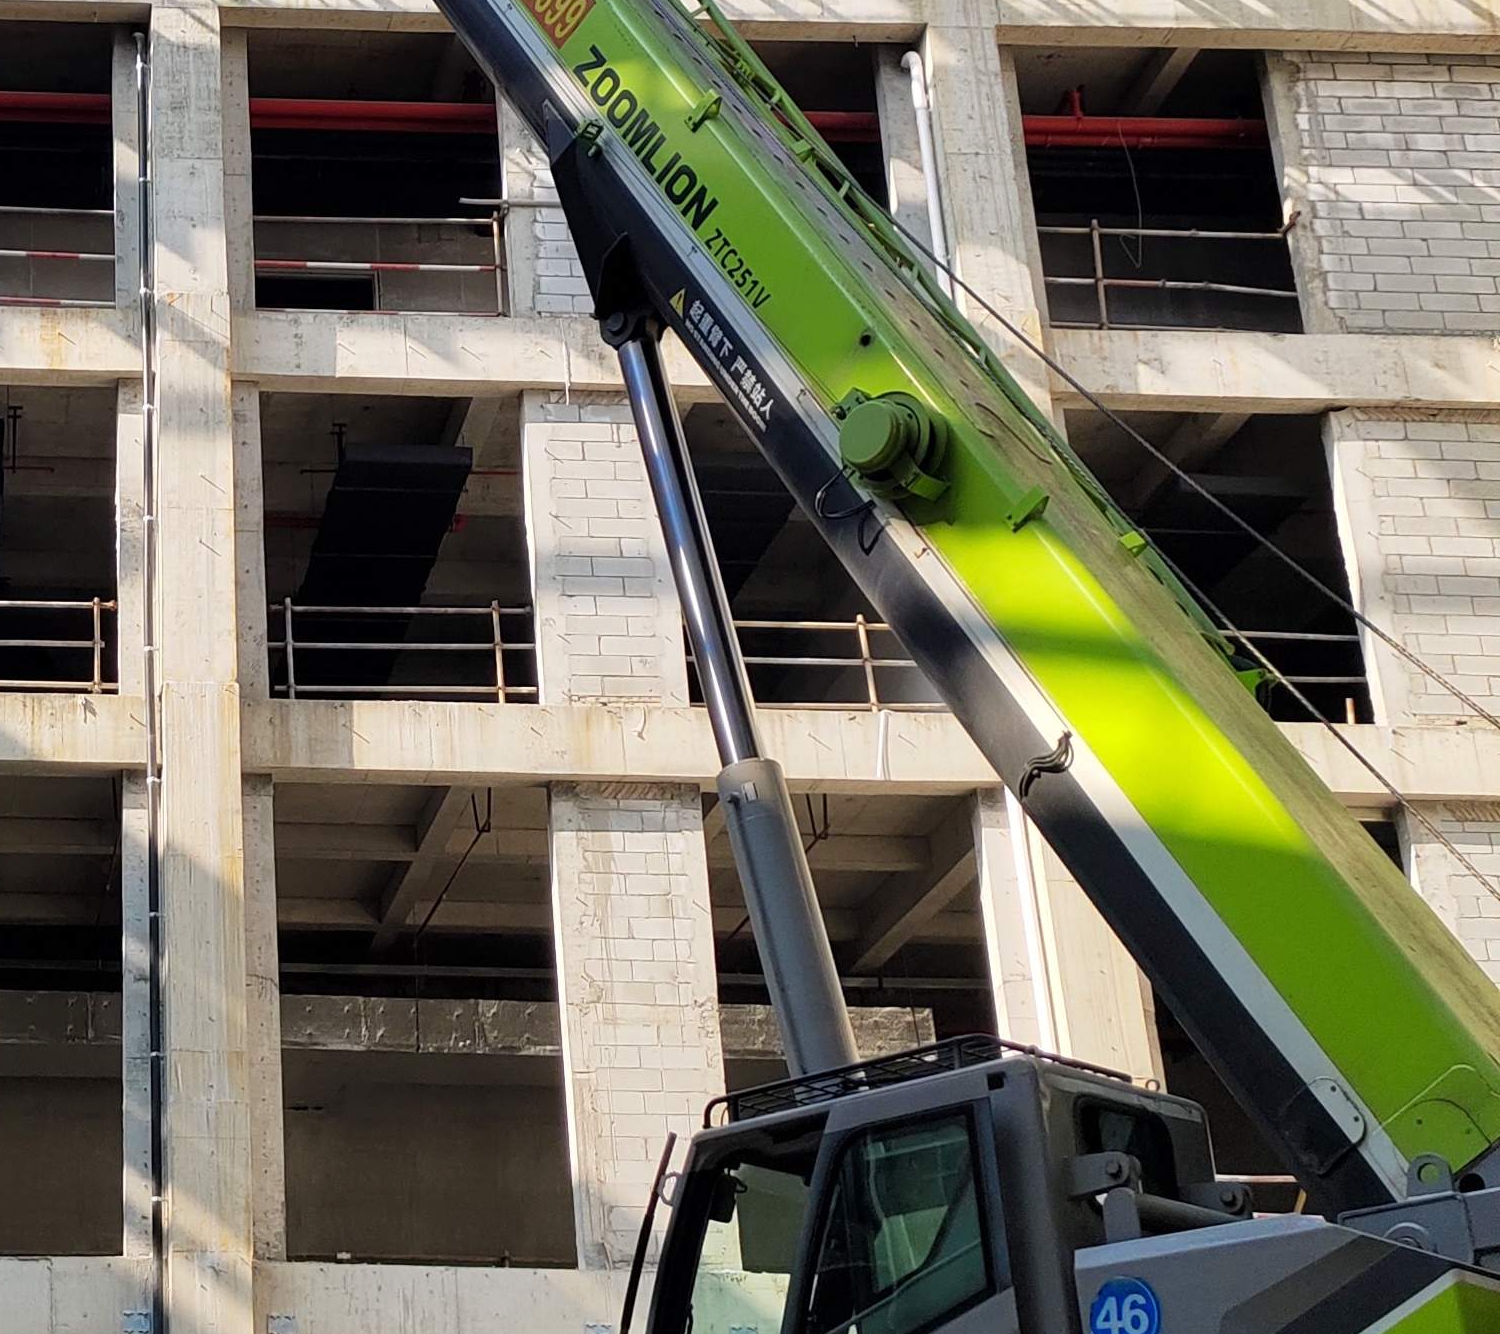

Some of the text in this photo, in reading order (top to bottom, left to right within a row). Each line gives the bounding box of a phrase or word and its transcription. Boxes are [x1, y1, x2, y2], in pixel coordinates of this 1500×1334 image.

[571, 44, 771, 309] ZOOMLION ZTC251V
[688, 299, 774, 420] 起重臂下 严禁站人
